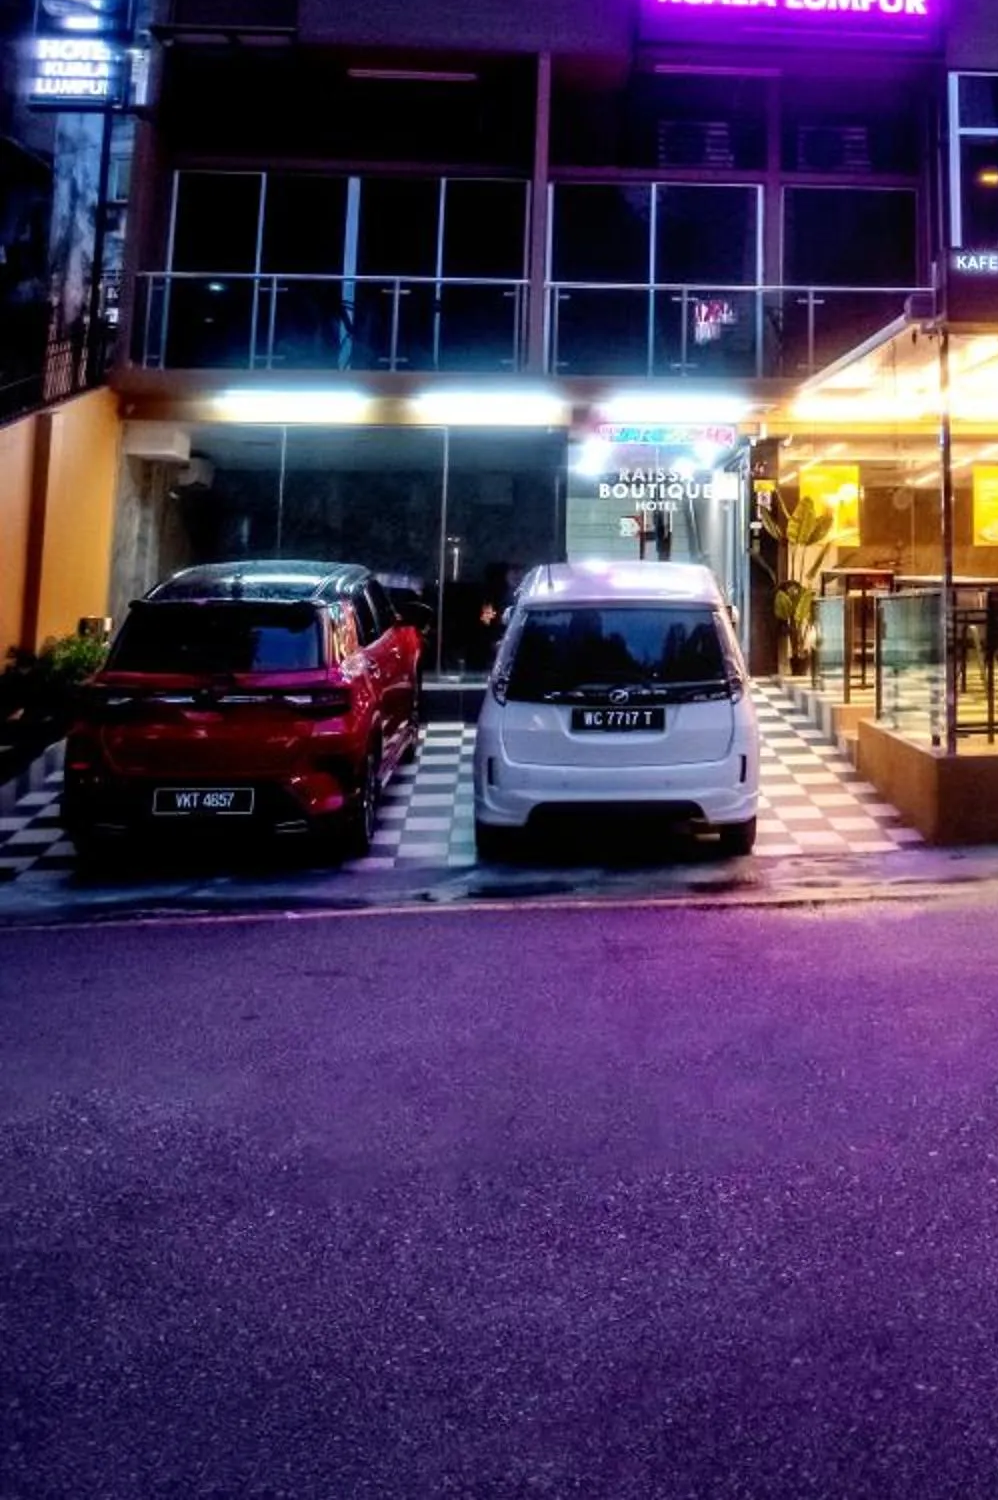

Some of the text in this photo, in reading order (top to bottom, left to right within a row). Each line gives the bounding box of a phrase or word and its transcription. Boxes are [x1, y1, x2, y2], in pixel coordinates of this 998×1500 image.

[955, 255, 998, 270] KAFE
[599, 483, 713, 500] BOUTIQUE
[635, 501, 678, 512] HOTEL
